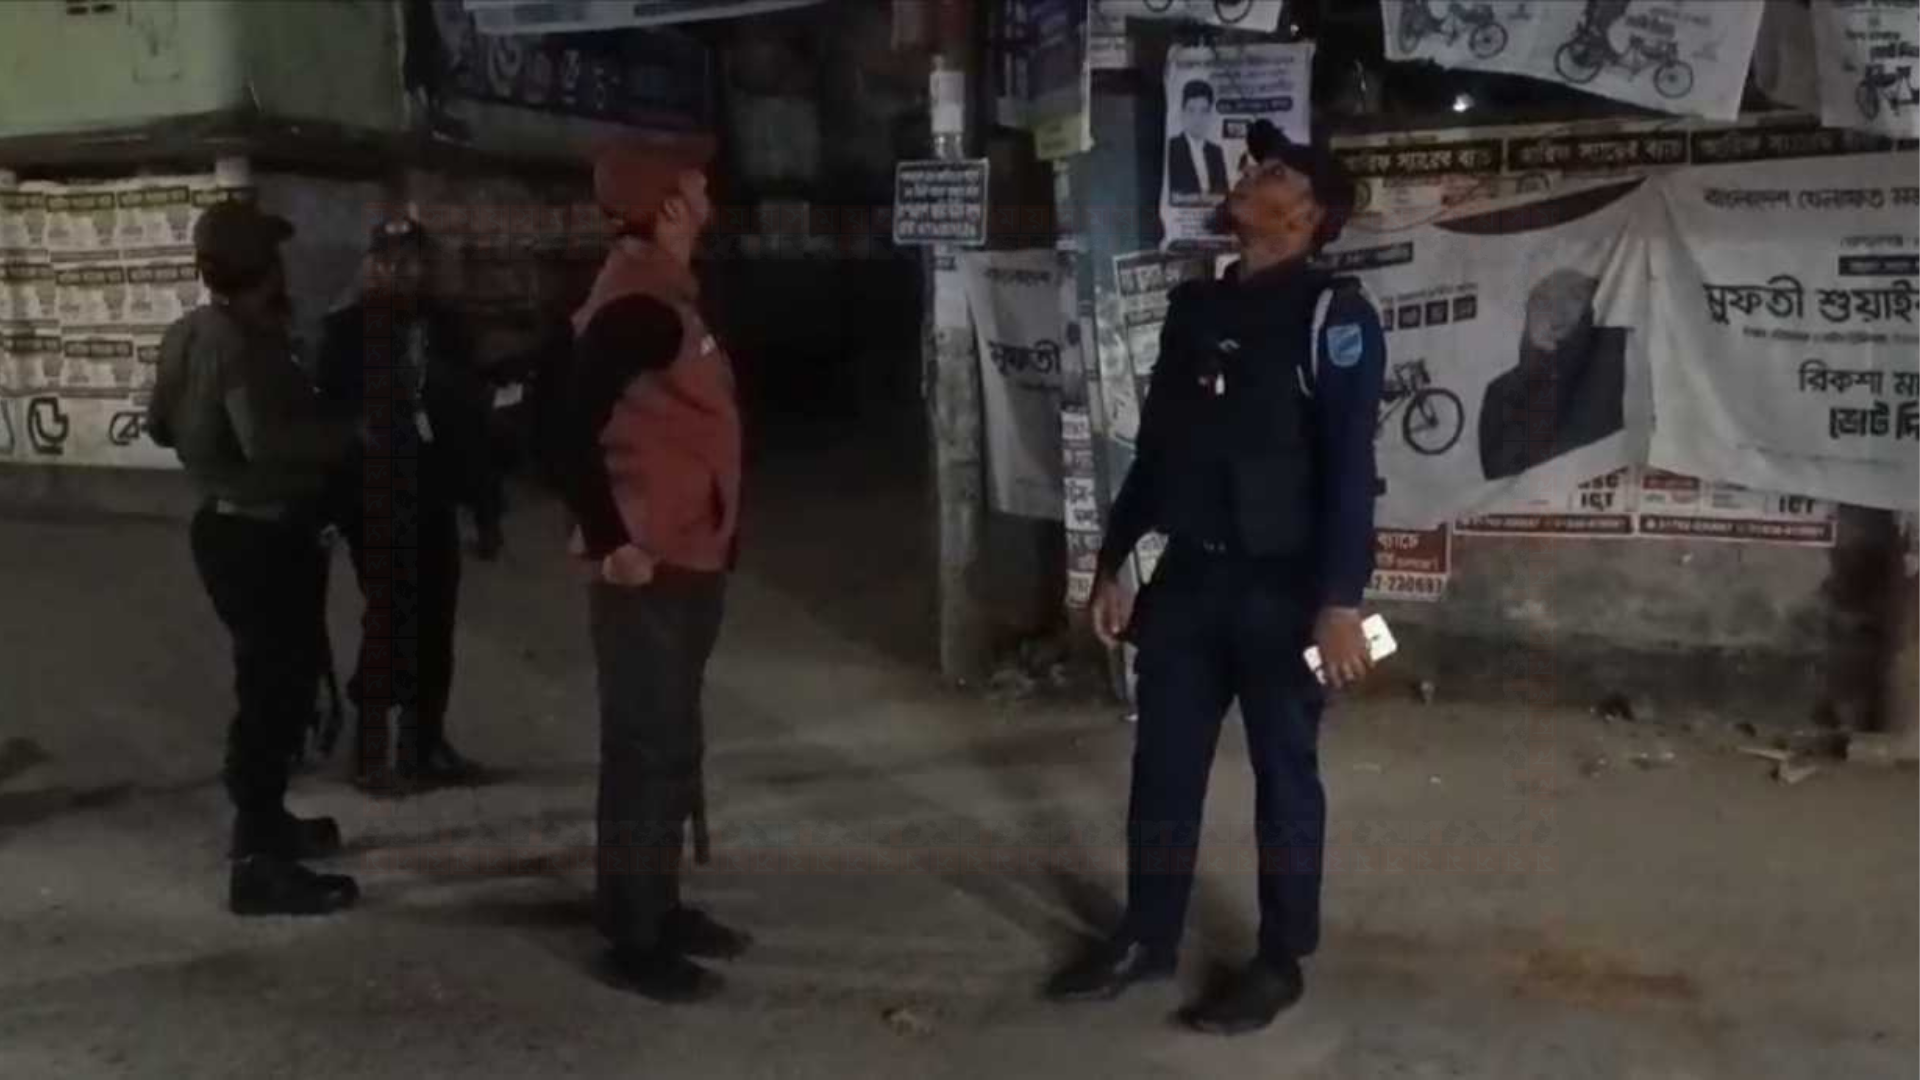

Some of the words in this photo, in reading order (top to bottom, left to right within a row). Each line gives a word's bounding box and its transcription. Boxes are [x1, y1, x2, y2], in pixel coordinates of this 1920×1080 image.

[1702, 275, 1804, 325] মুফতী
[1815, 280, 1919, 323] শুয়াই
[1798, 358, 1884, 394] রিকশা
[1578, 473, 1620, 489] SC
[1581, 492, 1615, 509] ICT
